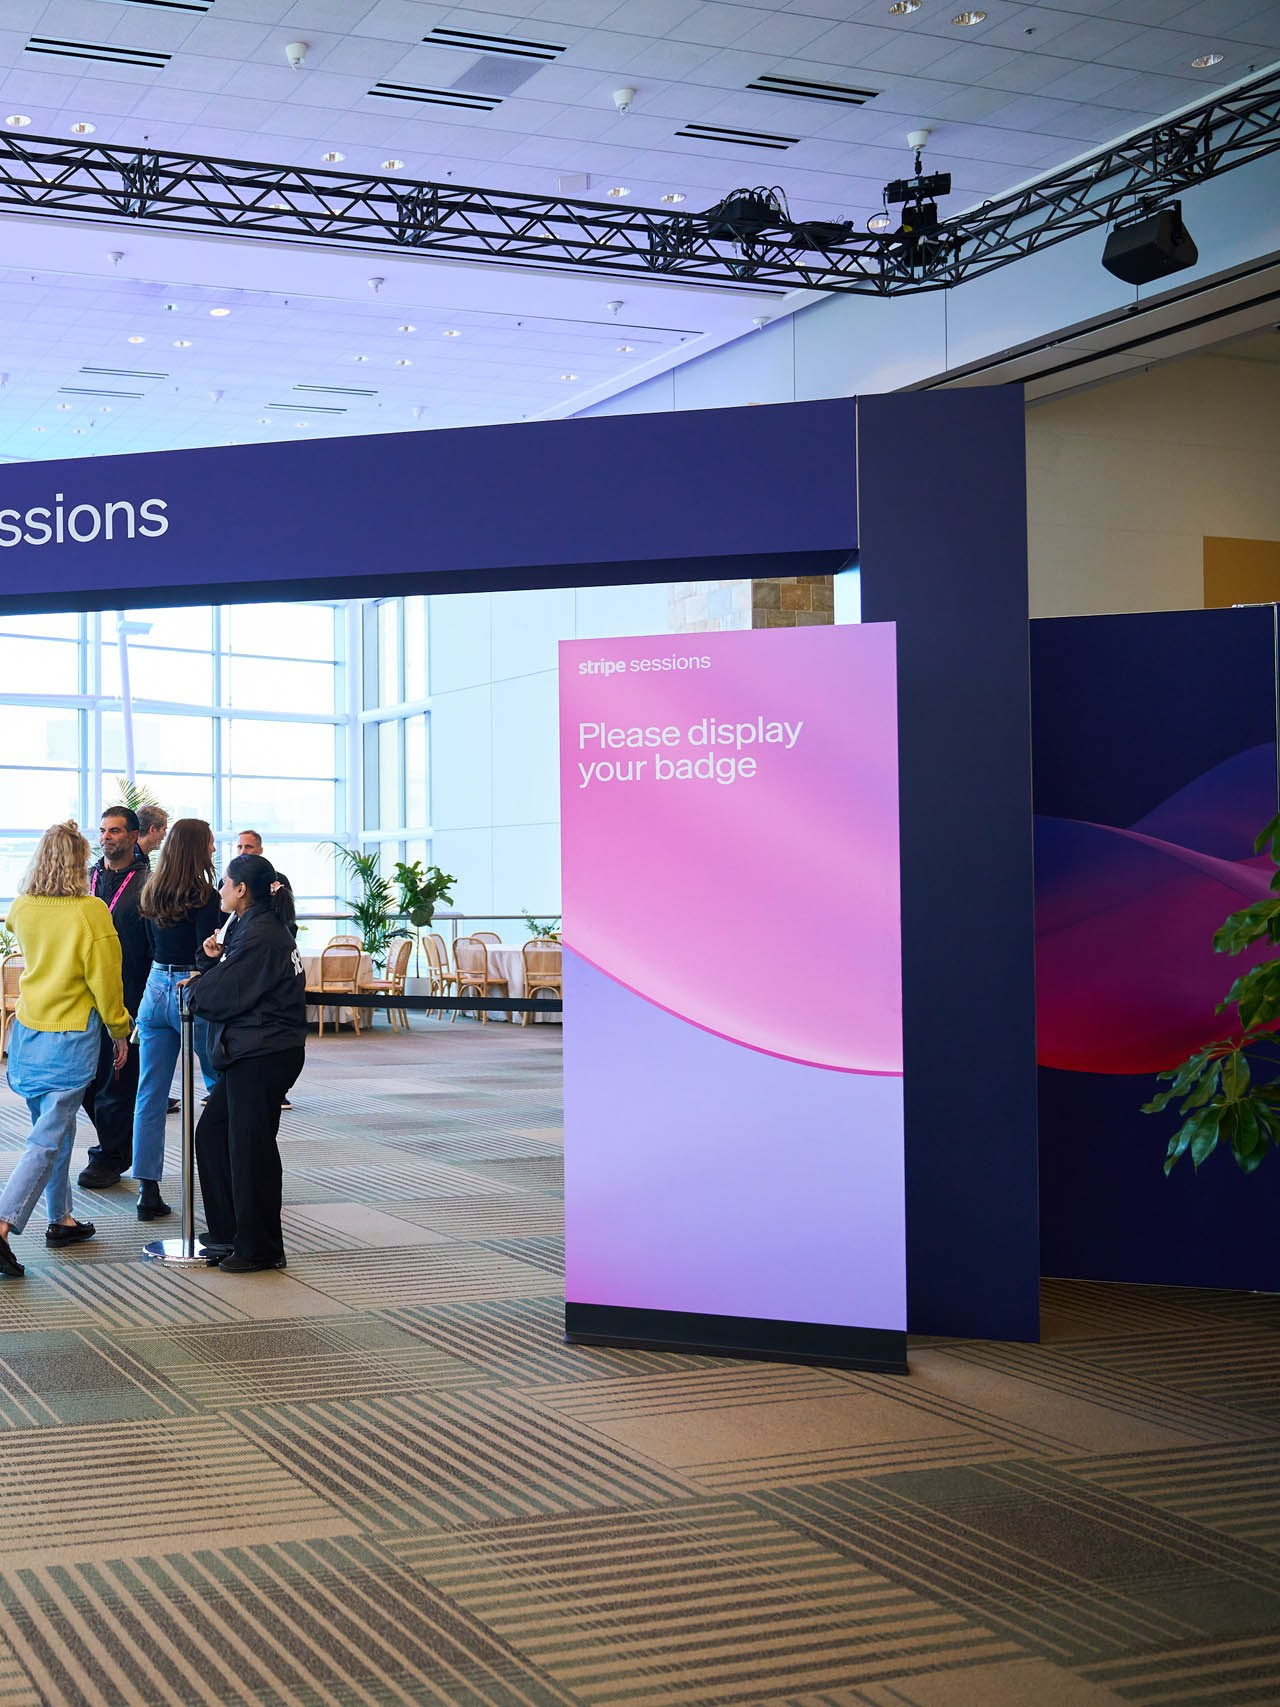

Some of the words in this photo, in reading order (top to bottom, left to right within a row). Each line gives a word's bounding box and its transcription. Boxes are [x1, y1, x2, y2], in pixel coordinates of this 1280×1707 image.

[578, 658, 627, 677] stripe
[629, 654, 712, 672] sessions
[579, 721, 681, 750] Please
[687, 715, 804, 751] display
[577, 759, 648, 789] your
[654, 751, 758, 785] badge
